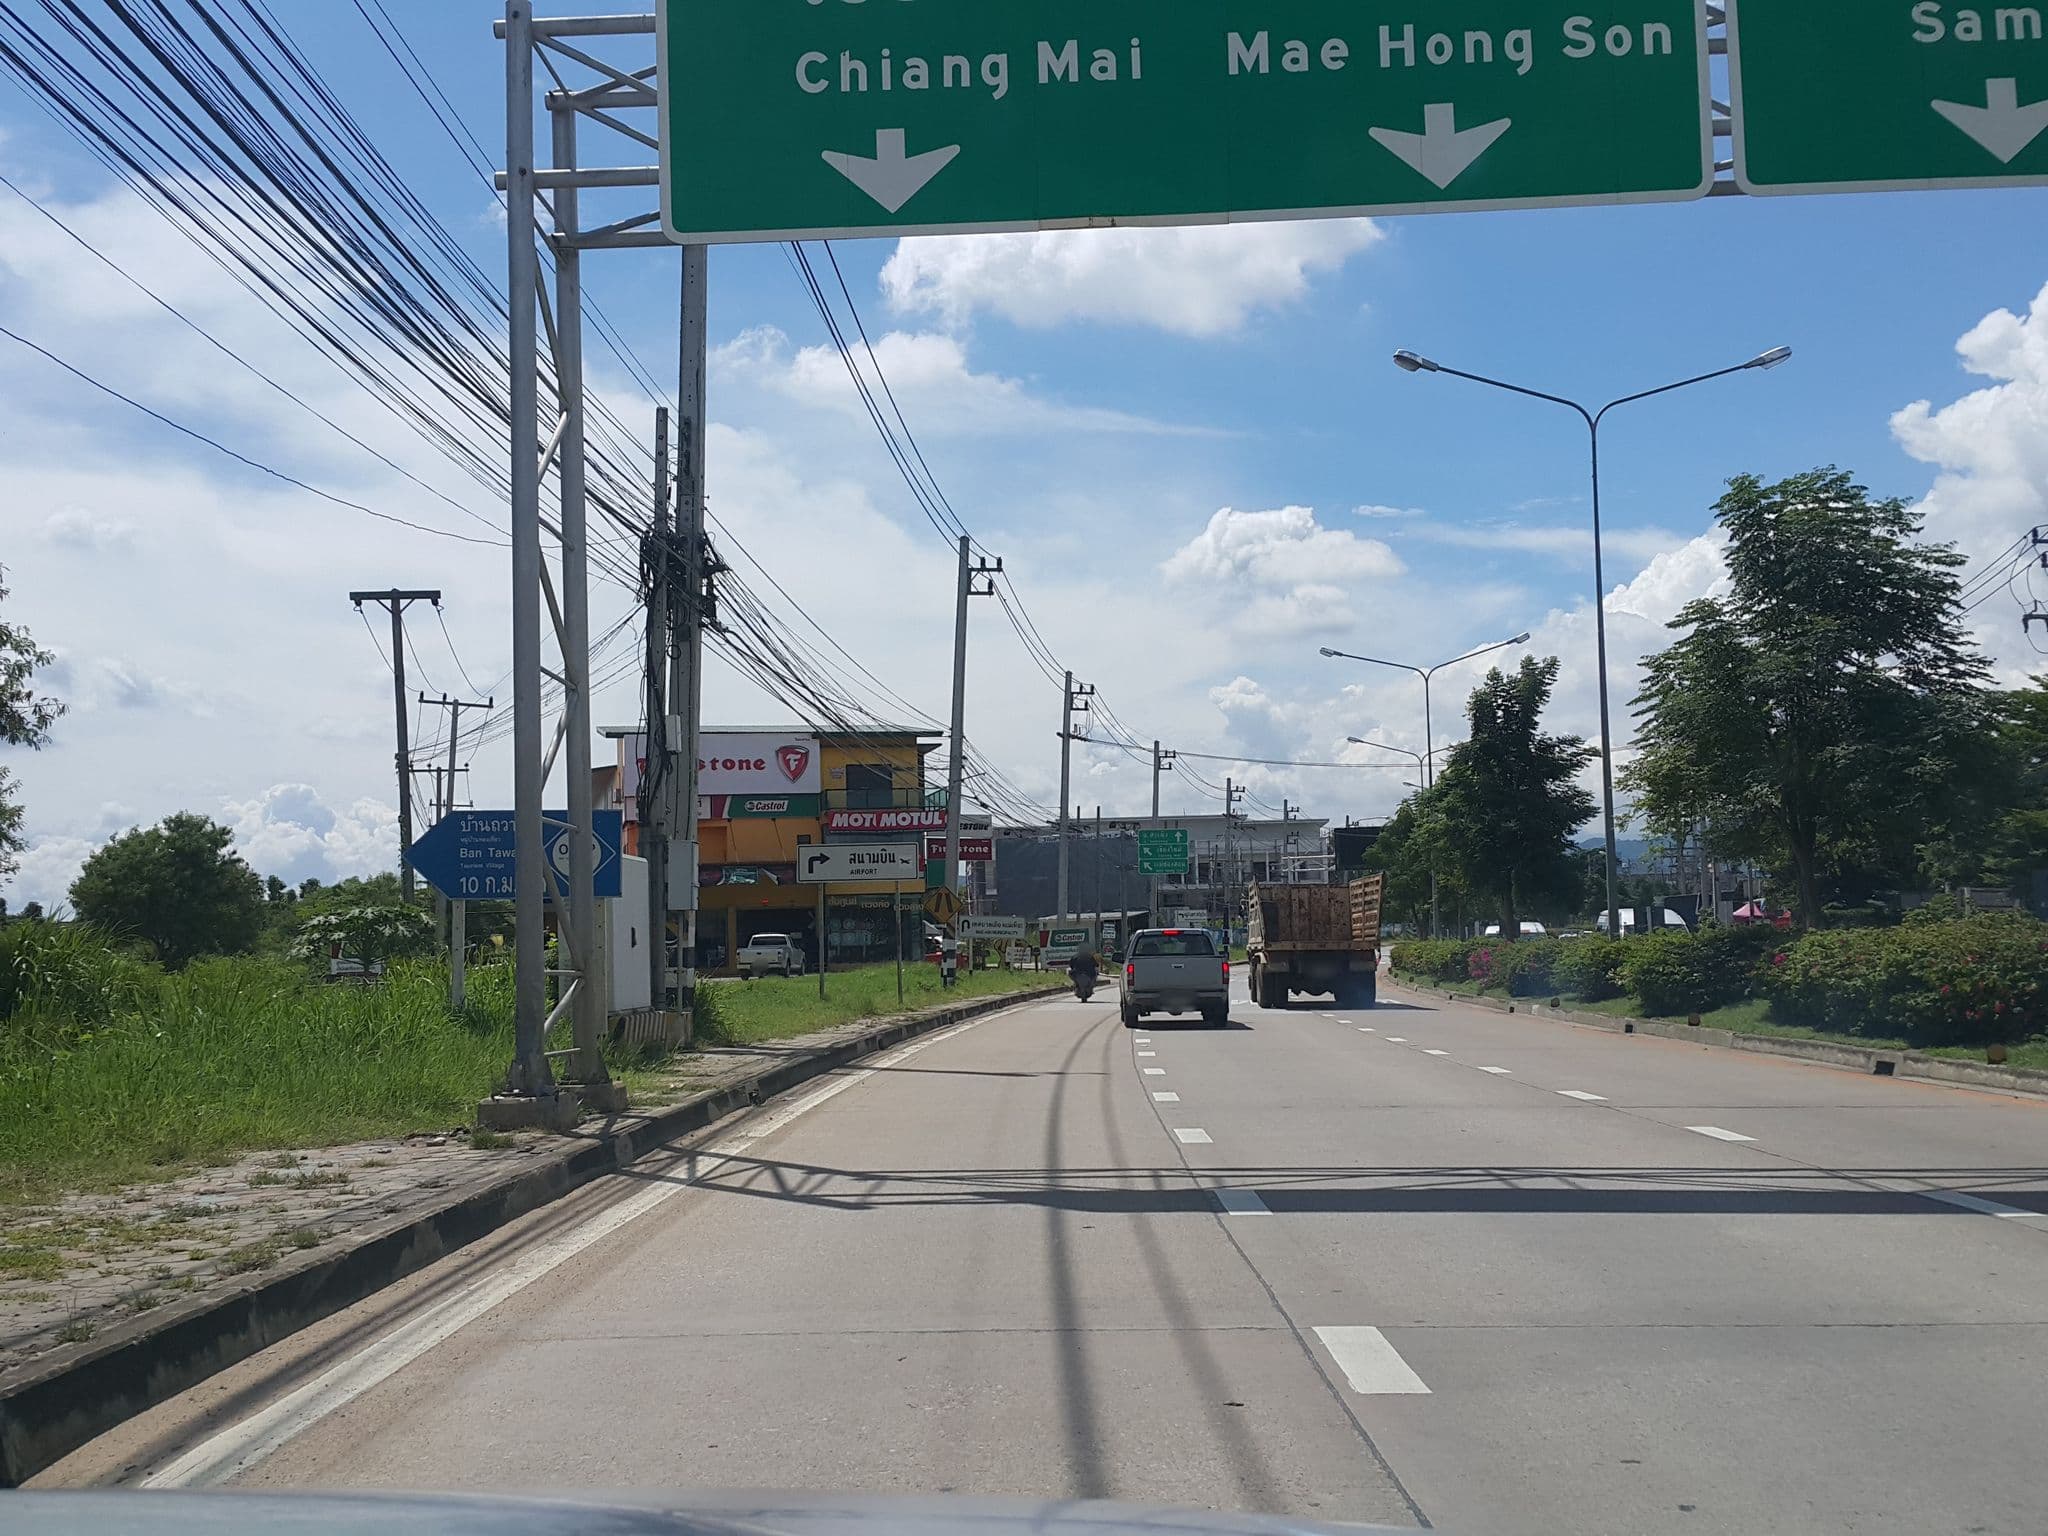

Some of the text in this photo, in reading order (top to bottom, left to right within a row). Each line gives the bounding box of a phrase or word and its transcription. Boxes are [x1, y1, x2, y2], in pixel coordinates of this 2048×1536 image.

[1911, 0, 2042, 44] Sam
[1227, 16, 1674, 76] Mae Hong Son
[795, 37, 1142, 101] Chiang Mai
[755, 801, 786, 811] Castrol
[460, 815, 516, 832] บ้านถวา
[832, 811, 942, 827] MOT MOTUL
[460, 848, 517, 858] Ban Tawa
[849, 848, 896, 865] สนามบิน
[460, 877, 479, 894] 10
